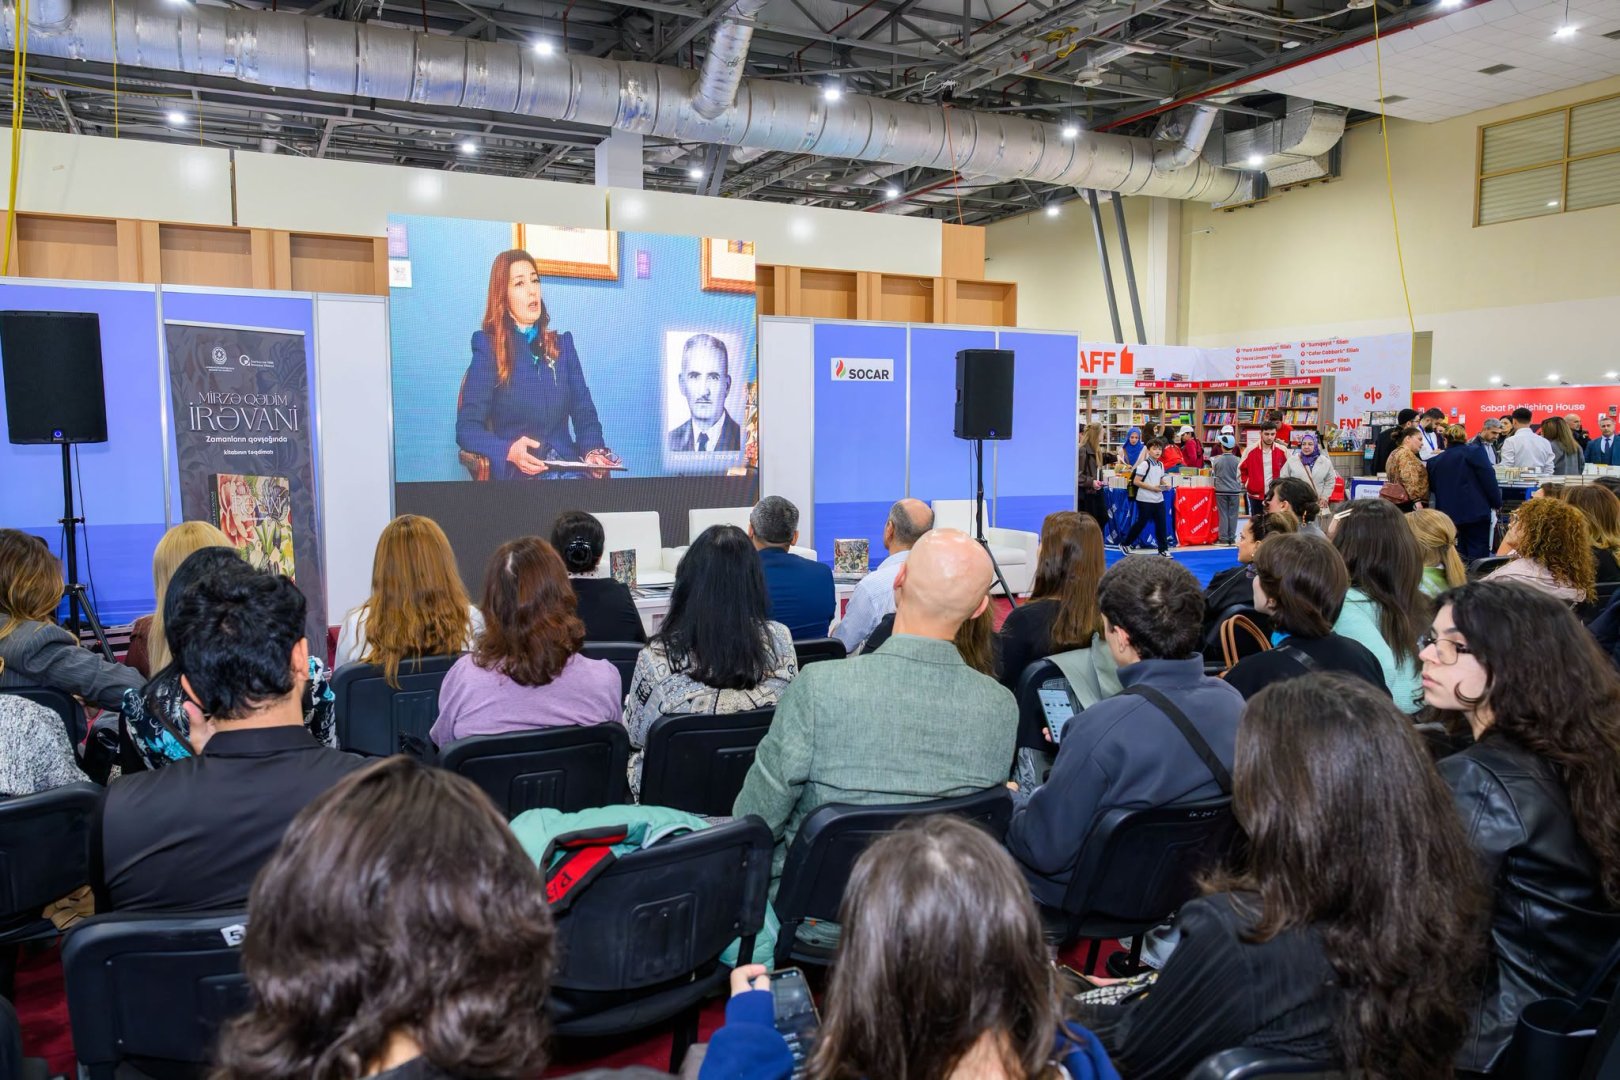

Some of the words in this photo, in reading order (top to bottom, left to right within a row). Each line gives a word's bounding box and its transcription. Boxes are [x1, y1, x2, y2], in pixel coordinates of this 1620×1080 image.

[849, 368, 889, 380] SOCAR
[199, 391, 242, 405] MİRZƏ
[244, 393, 288, 406] QƏDİM
[1480, 404, 1506, 412] Sabat
[1555, 403, 1586, 411] House
[189, 402, 298, 431] İRƏVANİ
[205, 435, 247, 443] Zamanların
[230, 930, 244, 941] 5
